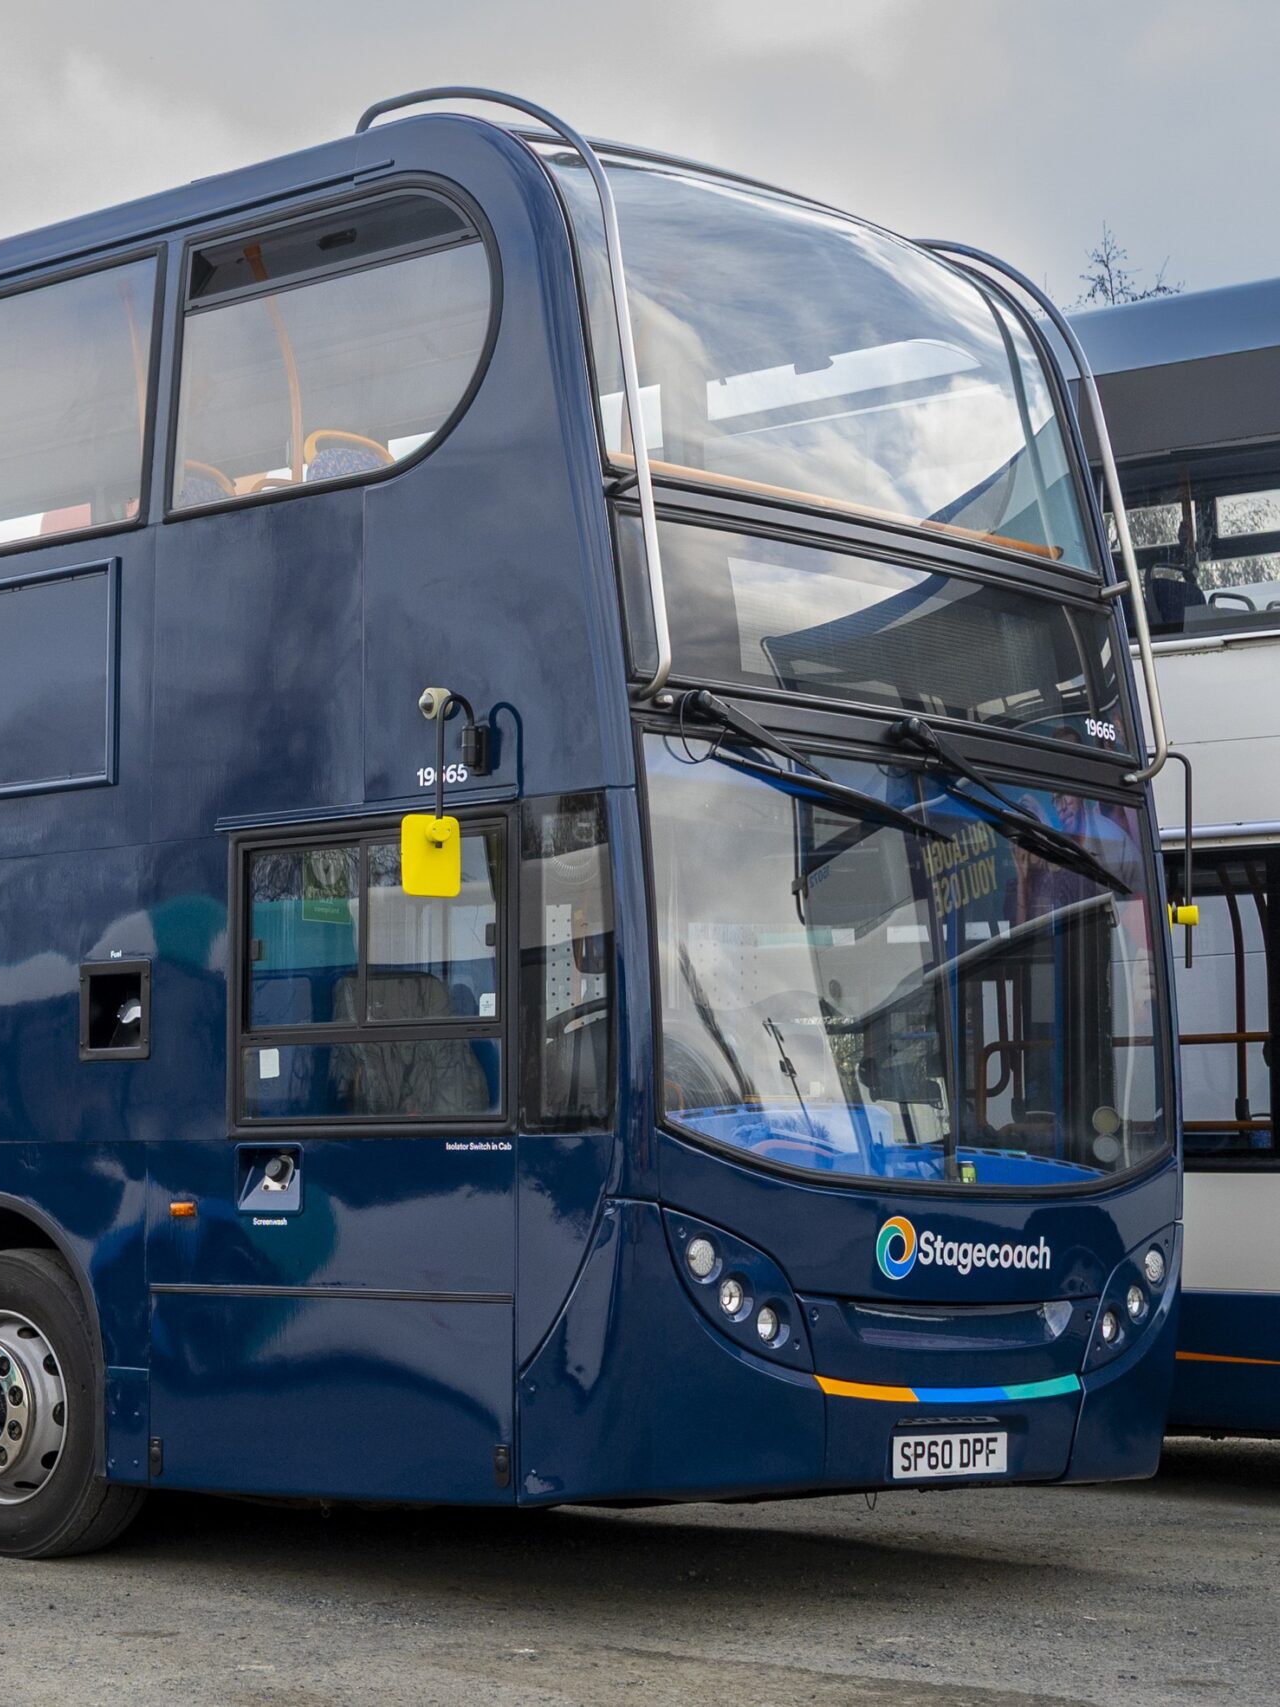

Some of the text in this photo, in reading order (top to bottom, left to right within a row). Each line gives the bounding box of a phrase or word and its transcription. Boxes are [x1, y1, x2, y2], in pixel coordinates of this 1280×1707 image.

[1084, 718, 1116, 741] 19665
[110, 949, 122, 958] Fuel
[445, 1142, 512, 1151] Isolator Switch in Cab
[253, 1217, 288, 1226] Screenwash
[918, 1231, 1051, 1275] Stagecoach
[901, 1437, 998, 1472] SP60 DPF
